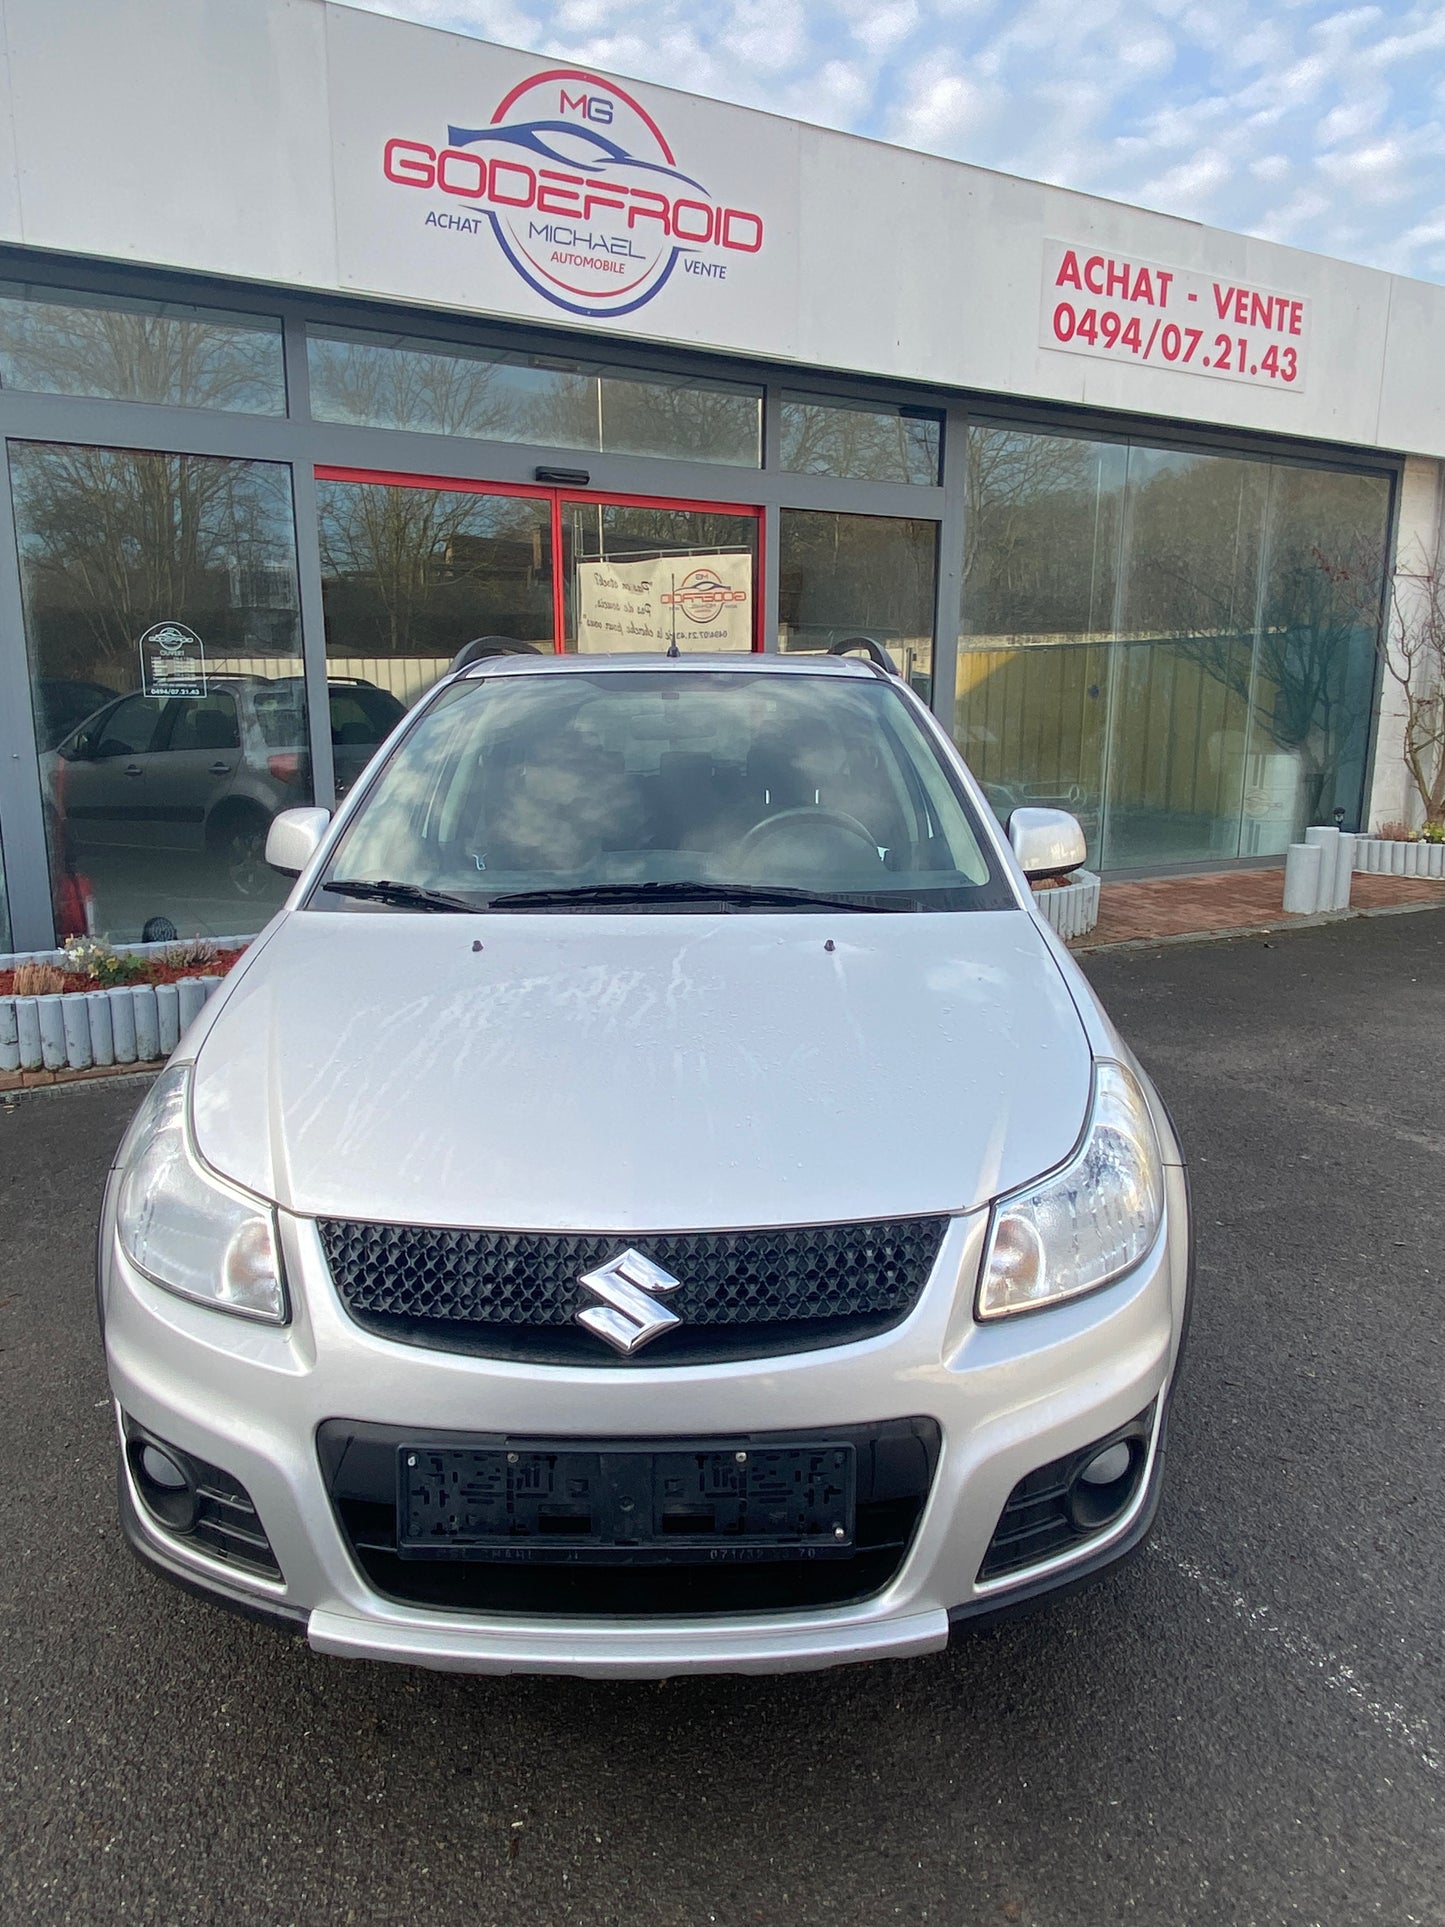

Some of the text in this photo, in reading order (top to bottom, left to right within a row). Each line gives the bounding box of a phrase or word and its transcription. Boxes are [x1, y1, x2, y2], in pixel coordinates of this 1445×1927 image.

[560, 88, 614, 125] MG
[383, 137, 763, 254] GODEFROID
[425, 211, 482, 234] ACHAT
[528, 221, 647, 260] MICHAEL
[550, 250, 626, 275] AUTOMOBILE
[683, 258, 727, 280] VENTE
[1055, 250, 1173, 308] ACHAT
[1212, 282, 1304, 336] VENTE
[1053, 301, 1298, 382] 0494/07.21.43
